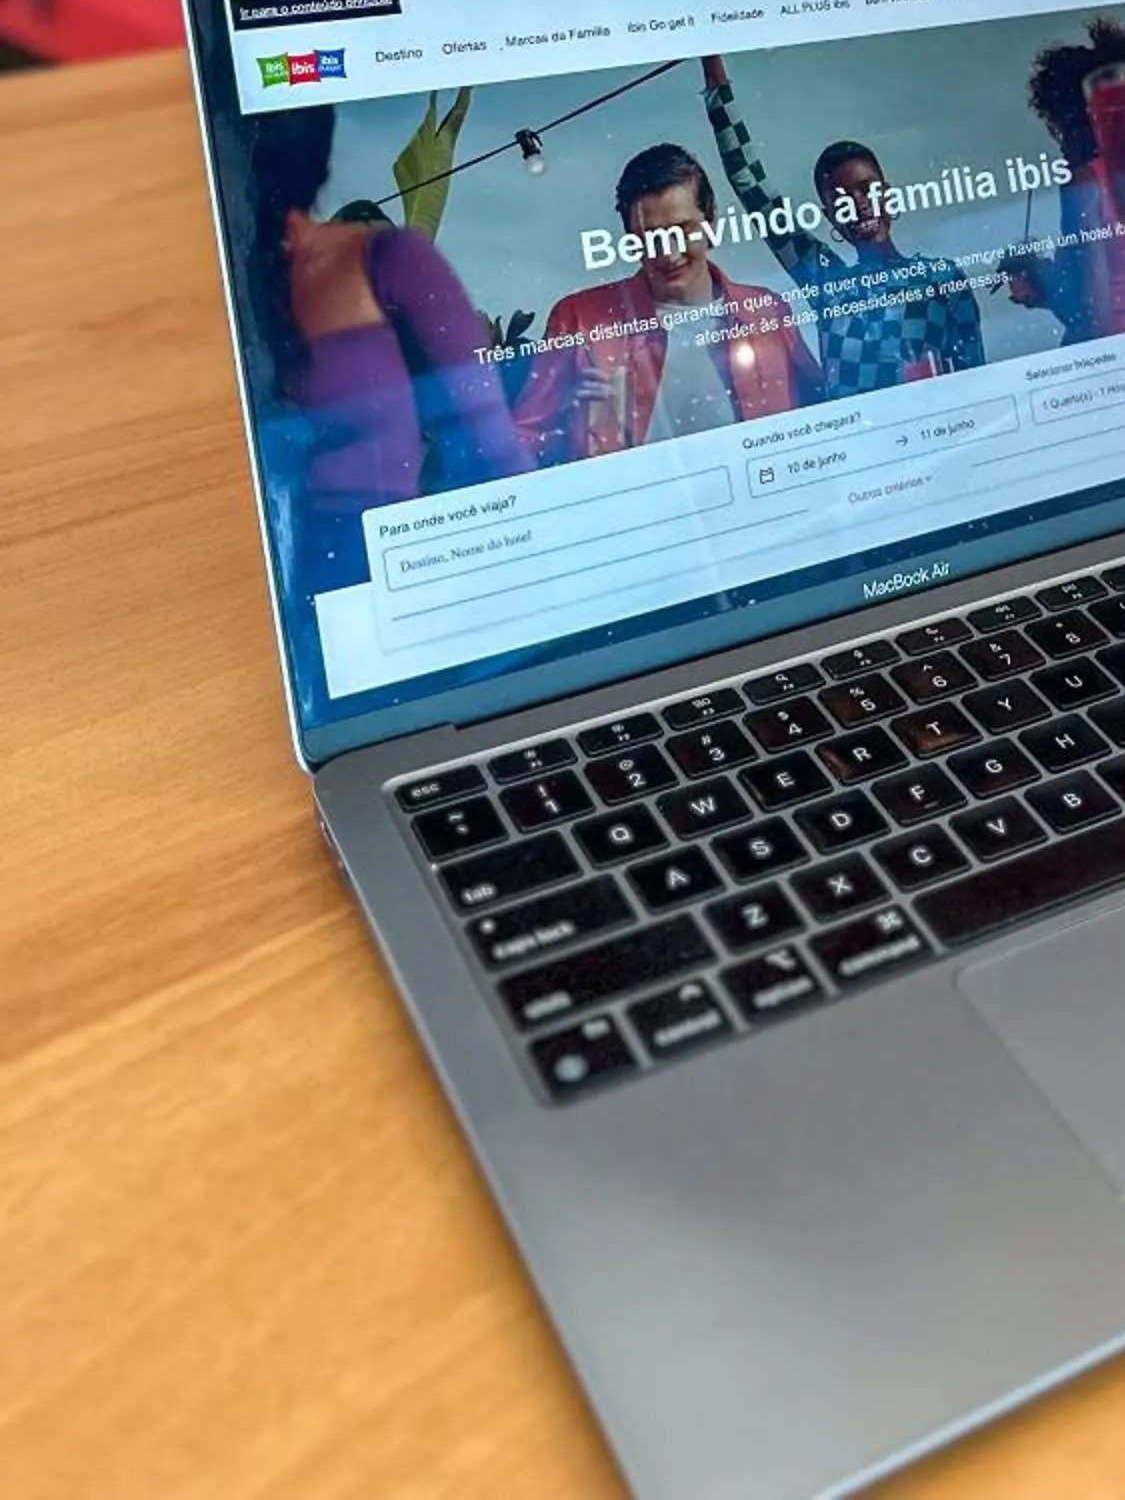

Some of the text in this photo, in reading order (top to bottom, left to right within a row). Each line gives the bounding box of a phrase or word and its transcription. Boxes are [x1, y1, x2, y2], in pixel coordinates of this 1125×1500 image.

[251, 7, 278, 20] para
[711, 8, 765, 24] Fidelidade
[780, 4, 799, 17] ALL
[801, 1, 831, 15] PLUS
[649, 19, 666, 32] Go
[668, 18, 686, 32] get
[442, 40, 487, 55] Ofertas
[505, 32, 548, 47] Marcas
[552, 31, 566, 43] da
[375, 47, 423, 63] Destino
[292, 61, 315, 75] ibis
[580, 152, 1074, 271] Bem-vindo à família ibis
[474, 345, 515, 365] Três
[519, 333, 585, 357] marcas
[589, 317, 659, 344] distintas
[664, 302, 739, 329] garantem
[743, 292, 778, 314] que,
[781, 281, 820, 304] onde
[823, 277, 857, 301] quer
[861, 271, 889, 296] que
[891, 259, 927, 283] você
[929, 255, 951, 276] vá,
[954, 247, 1005, 271] sempre
[1008, 235, 1054, 258] haverá
[1057, 233, 1078, 248] um
[1080, 224, 1113, 244] hotel
[694, 269, 1014, 347] atender às suas necessidades e interesses.
[1026, 362, 1073, 381] Selecionar
[742, 410, 861, 450] Quando você chegará?
[920, 418, 975, 441] 11 de junho
[788, 450, 847, 475] 10 de junho
[848, 486, 883, 503] Outros
[379, 494, 517, 539] Para onde você viaja?
[400, 529, 532, 574] Destino, Nome do hotel
[863, 561, 951, 599] MacBook Air
[1066, 632, 1081, 644] 8
[999, 652, 1011, 666] 7
[932, 675, 947, 688] 6
[1065, 675, 1082, 689] U
[861, 697, 877, 712] 5
[997, 696, 1014, 712] Y
[788, 722, 803, 736] 4
[925, 720, 942, 736] T
[1055, 733, 1076, 749] H
[708, 747, 726, 762] 3
[852, 746, 873, 762] R
[618, 759, 635, 771] @
[985, 758, 1003, 774] G
[628, 773, 646, 788] 2
[777, 771, 796, 788] E
[411, 780, 440, 798] esc
[909, 783, 928, 800] F
[545, 800, 560, 815] 1
[690, 796, 717, 816] W
[1062, 792, 1082, 809] B
[831, 811, 853, 829] D
[985, 818, 1007, 836] V
[611, 826, 631, 844] Q
[751, 838, 773, 858] S
[910, 846, 933, 865] C
[665, 866, 690, 890] A
[828, 876, 854, 896] X
[463, 884, 496, 903] tab
[742, 904, 769, 928] Z
